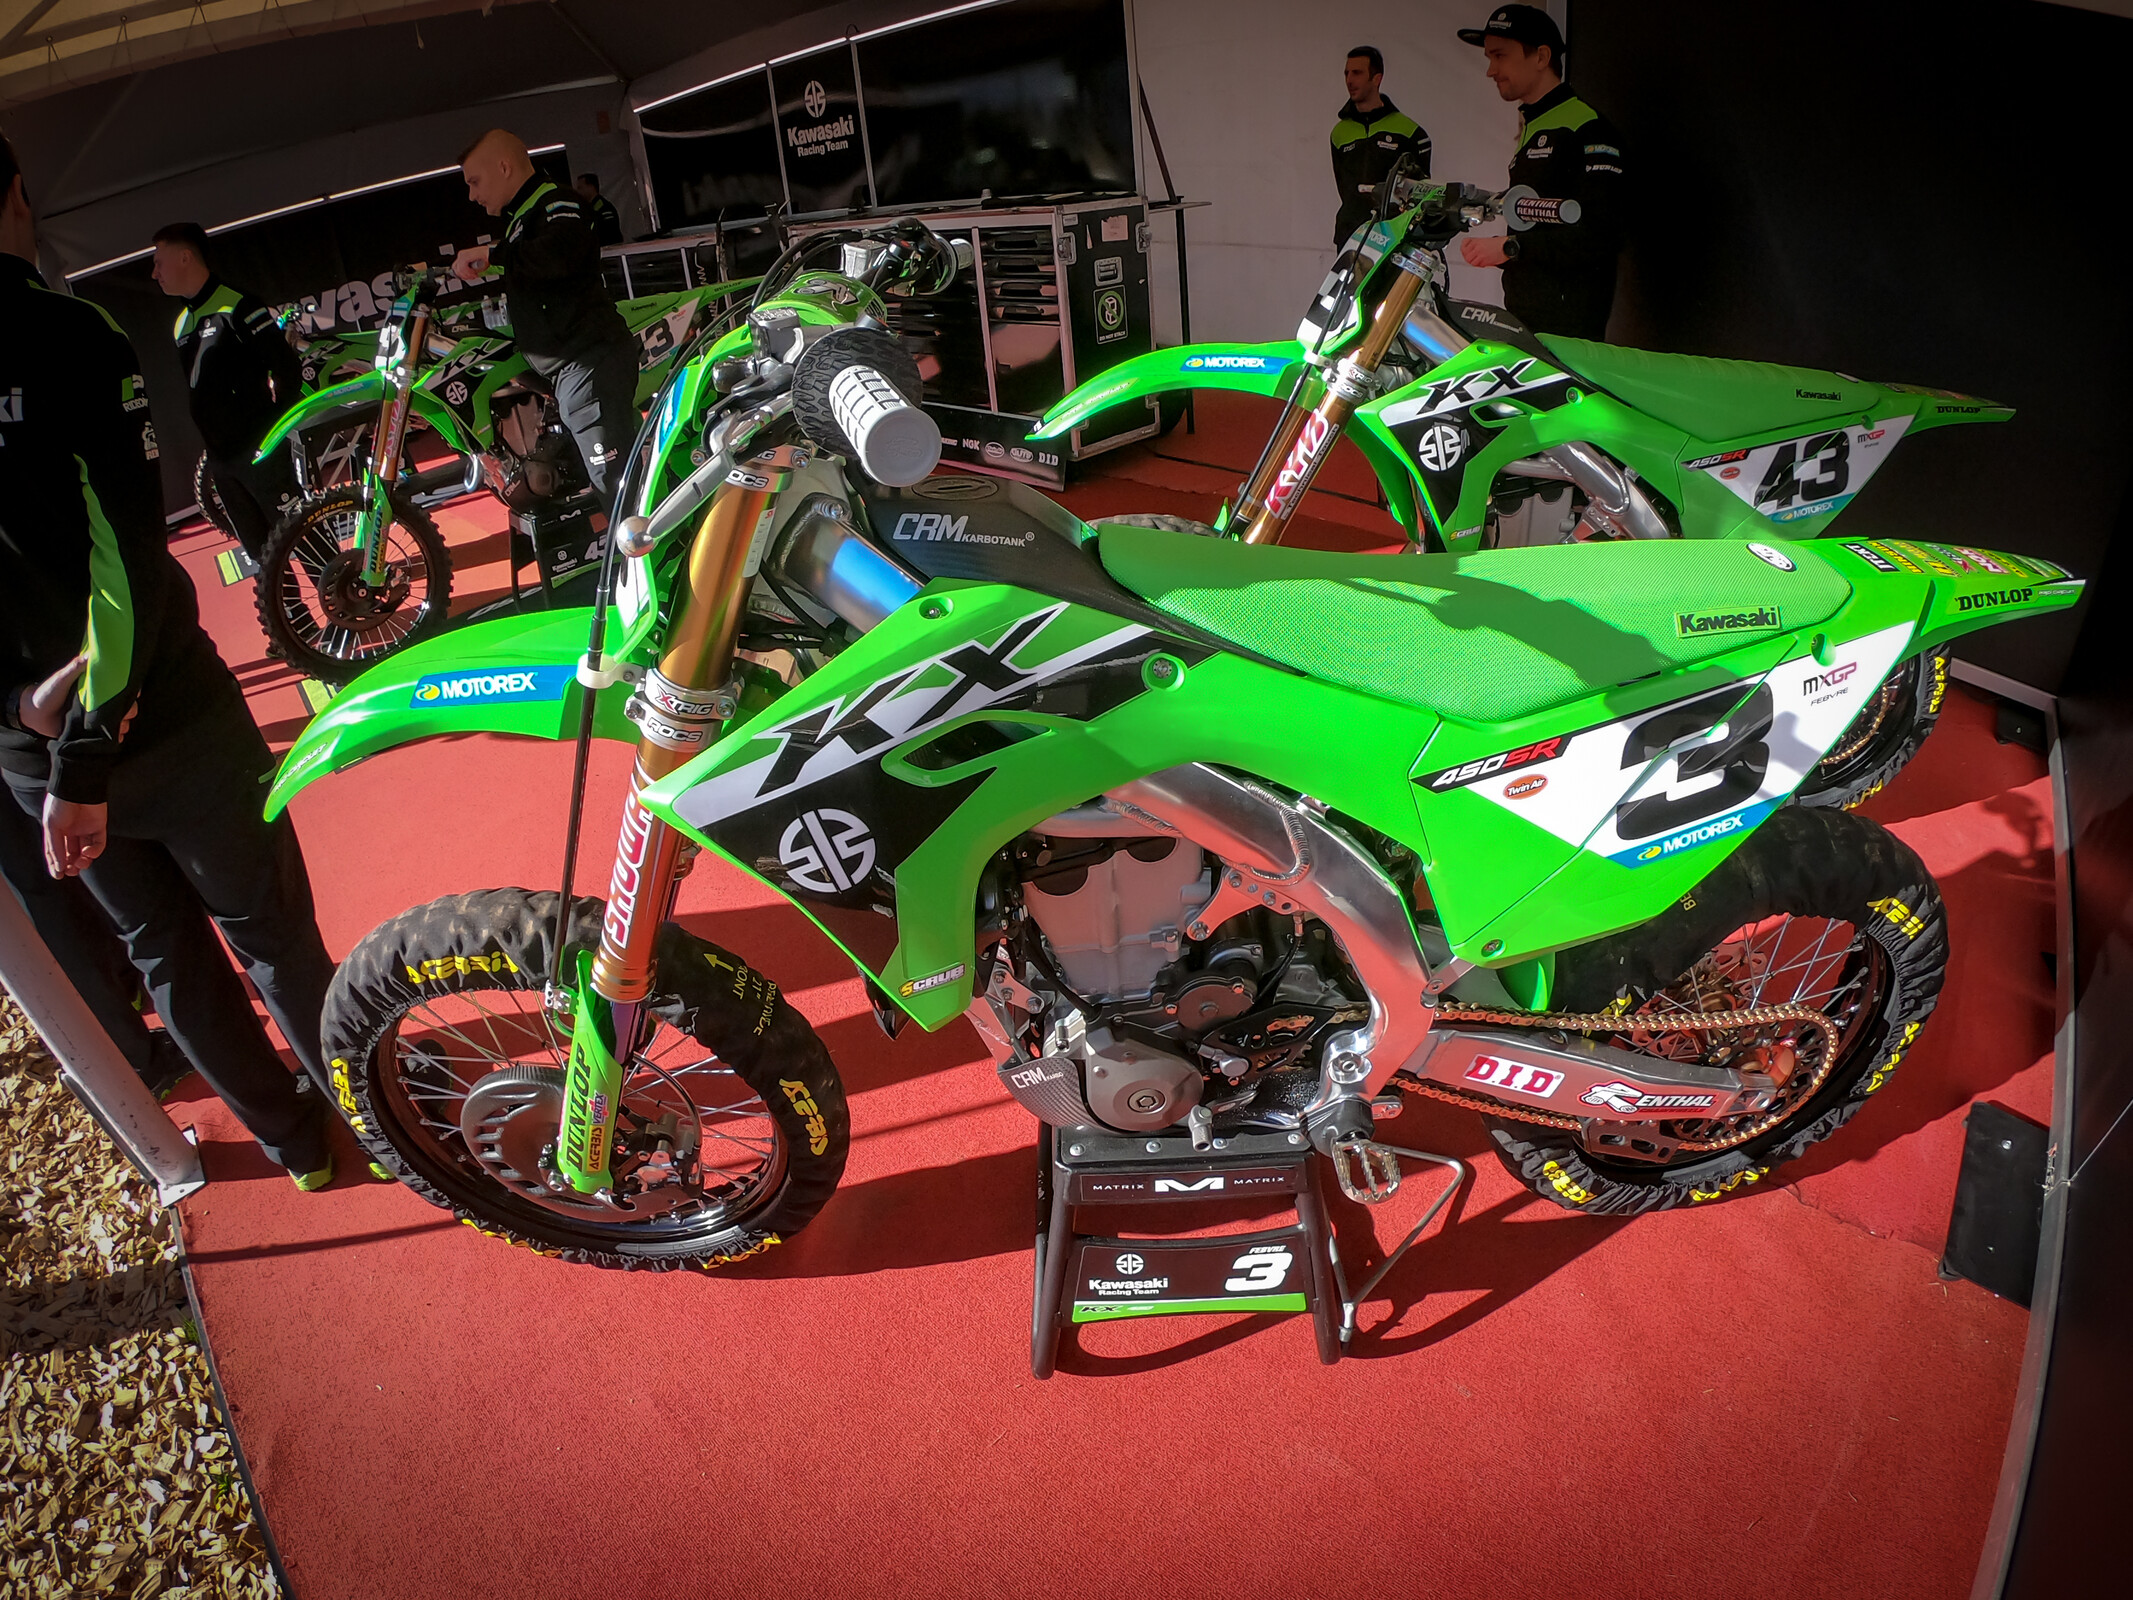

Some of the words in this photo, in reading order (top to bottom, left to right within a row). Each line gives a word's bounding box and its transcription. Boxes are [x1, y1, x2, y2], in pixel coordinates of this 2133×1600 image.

[787, 114, 855, 147] Kawasaki
[797, 143, 825, 157] Racing
[825, 140, 849, 152] Team
[1517, 207, 1558, 217] RENTHAL
[1461, 306, 1497, 325] CRM
[1205, 356, 1265, 368] MOTOREX
[1416, 358, 1537, 416] KX
[1795, 388, 1842, 401] Kawasaki
[1936, 405, 1981, 414] DUNLOP
[962, 438, 981, 452] NGK
[1857, 429, 1885, 443] MXGP
[1688, 449, 1747, 469] 450SR
[1754, 430, 1850, 510] 43
[725, 469, 769, 488] OCS
[306, 499, 354, 524] DUNLOP
[1793, 500, 1834, 519] MOTOREX
[893, 513, 969, 542] CRM
[1958, 588, 2033, 612] DUNLOP
[1680, 607, 1777, 634] Kawasaki
[441, 673, 537, 700] MOTOREX
[1803, 661, 1858, 697] MXGP
[656, 684, 715, 716] XTRIG
[754, 602, 1063, 798] KX
[1810, 687, 1849, 707] FEBVRE
[647, 716, 703, 743] ROCS
[1431, 737, 1562, 789] 450SR
[1616, 682, 1774, 841] 3
[1506, 782, 1528, 797] Twin
[1528, 778, 1546, 791] Air
[1663, 812, 1746, 854] MOTOREX
[900, 963, 966, 997] SCRUB
[1011, 1067, 1048, 1089] CRM
[566, 1042, 591, 1173] DUNLOP
[592, 1092, 606, 1124] VERTEX
[589, 1127, 603, 1171] ACERBIS
[1092, 1183, 1145, 1191] MATRIX
[1234, 1176, 1285, 1185] MATRIX
[1089, 1277, 1169, 1291] Kawasaki
[1224, 1252, 1294, 1293] 3
[1098, 1288, 1131, 1296] Racing
